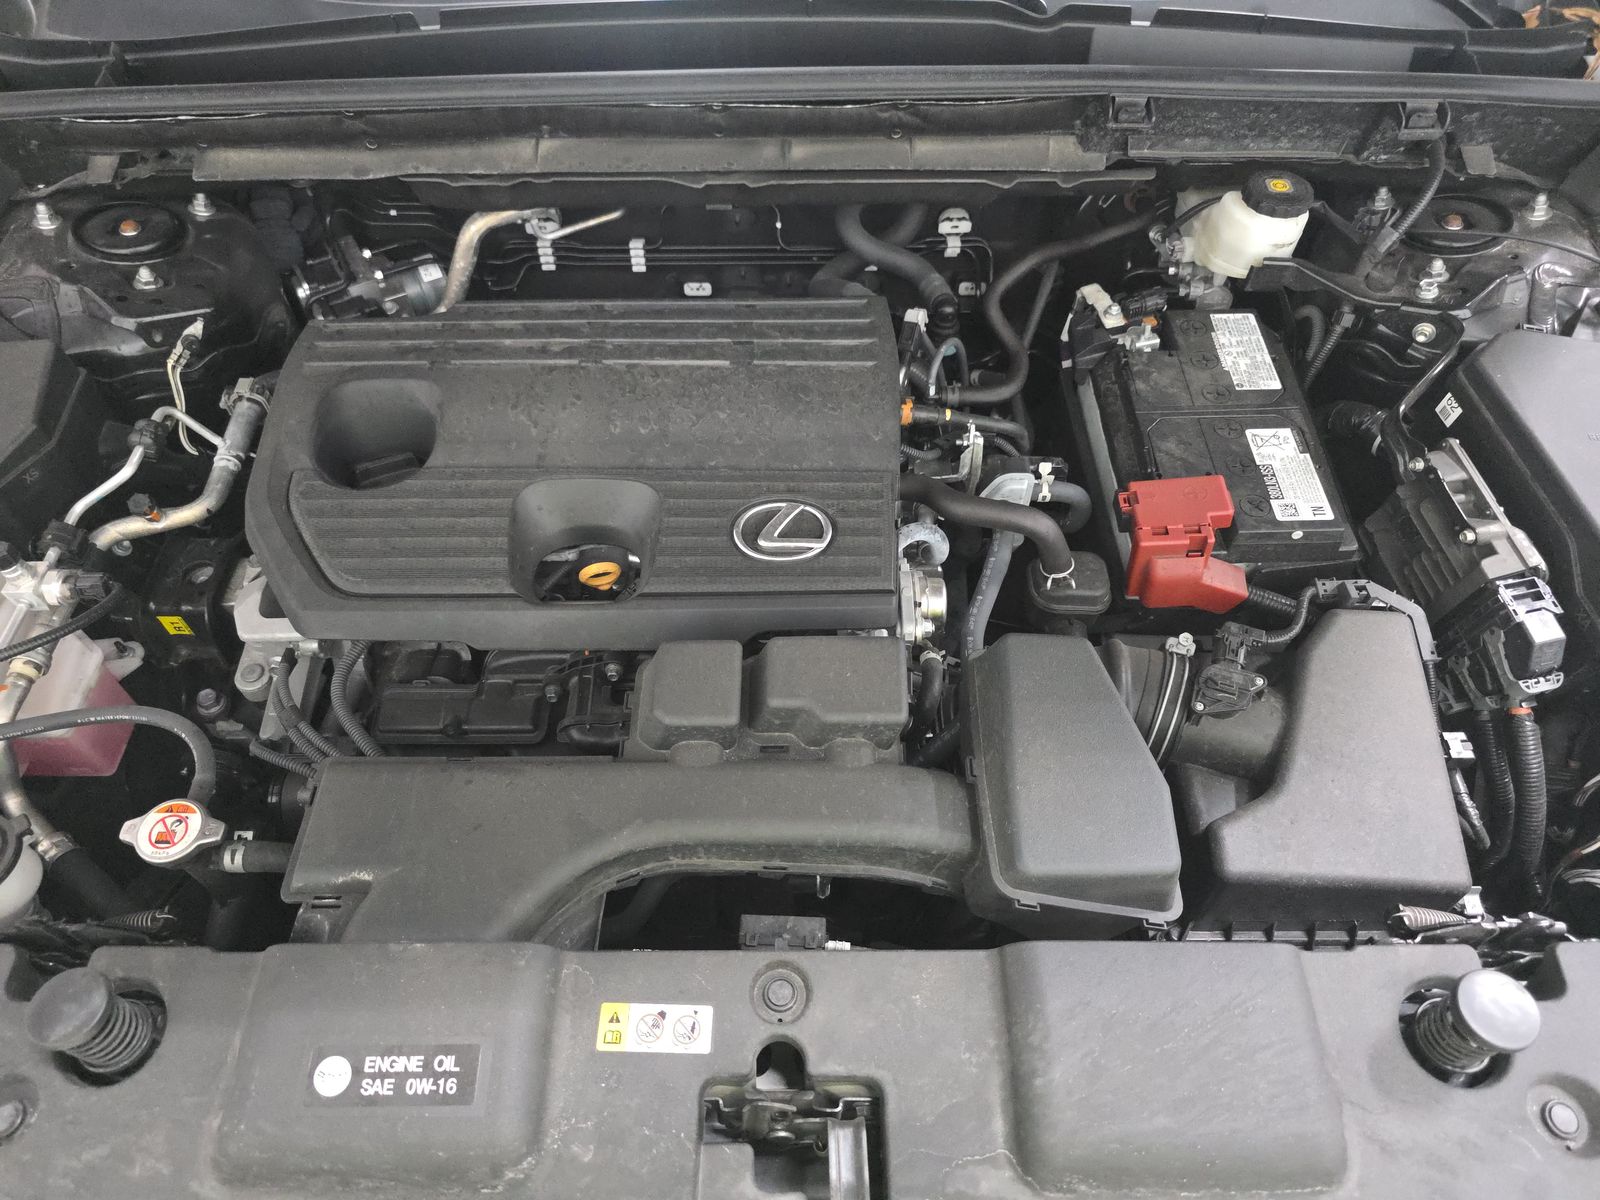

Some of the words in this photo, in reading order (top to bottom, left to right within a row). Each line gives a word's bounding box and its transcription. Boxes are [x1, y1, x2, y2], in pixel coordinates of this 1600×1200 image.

[1310, 506, 1326, 517] TN
[363, 1055, 424, 1073] ENGINE
[433, 1054, 460, 1072] OIL
[360, 1078, 395, 1096] SAE
[405, 1077, 458, 1095] 0W-16
